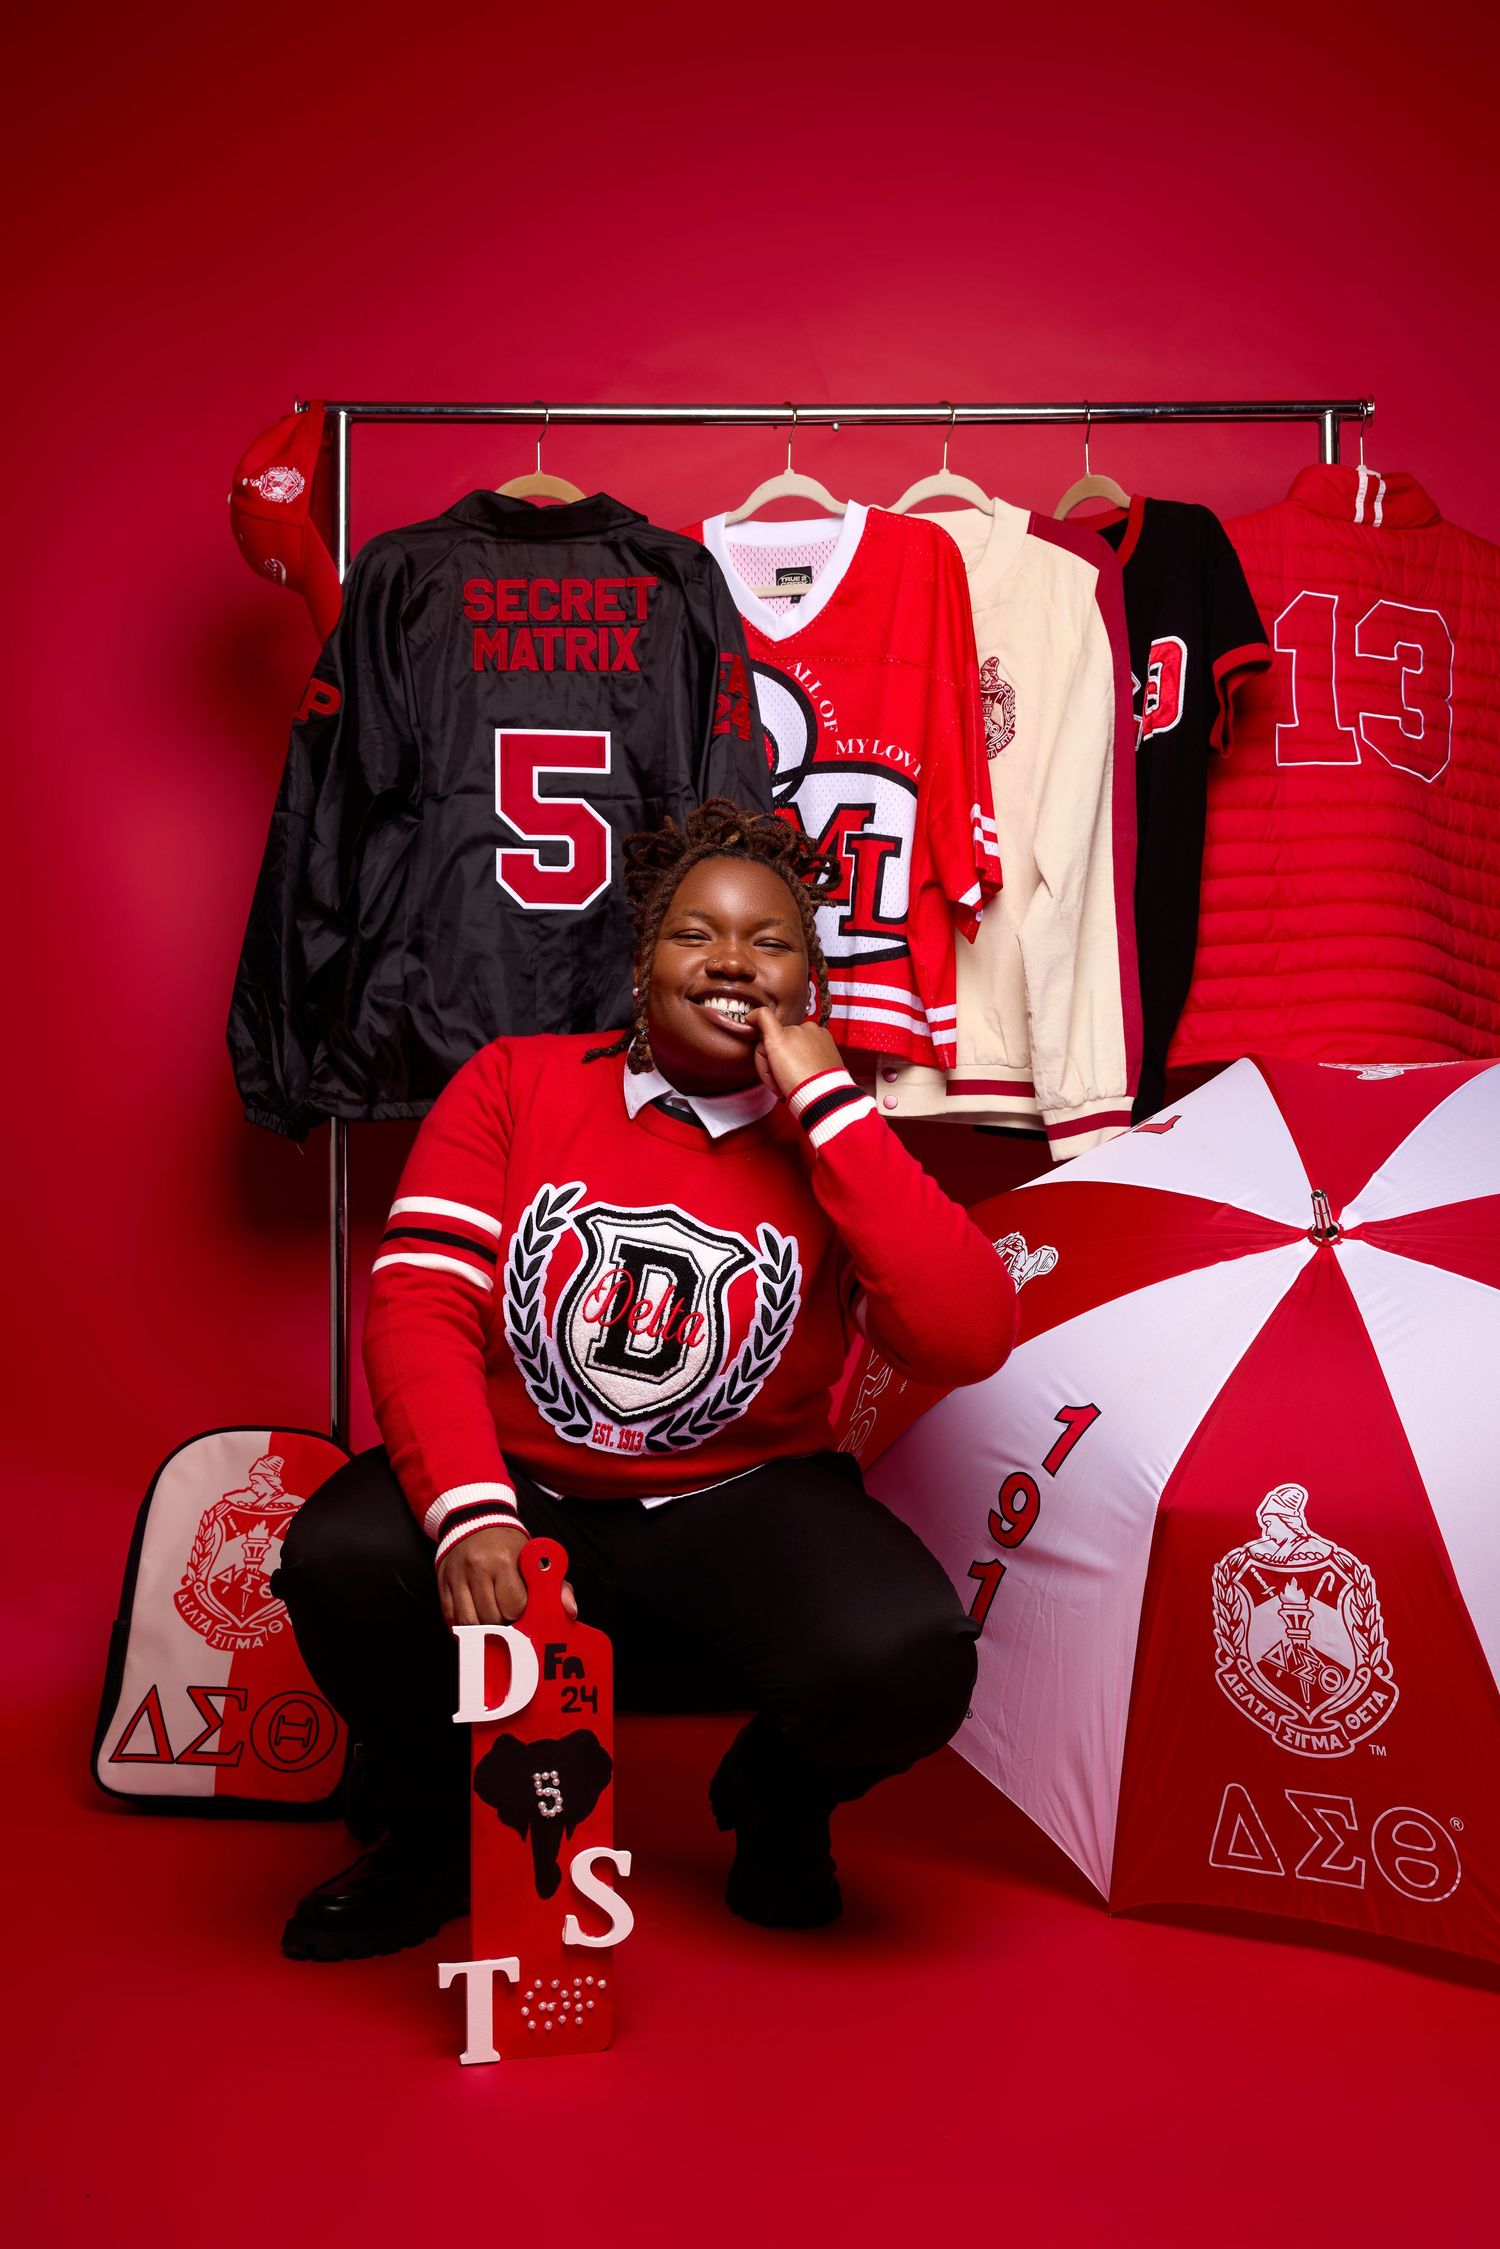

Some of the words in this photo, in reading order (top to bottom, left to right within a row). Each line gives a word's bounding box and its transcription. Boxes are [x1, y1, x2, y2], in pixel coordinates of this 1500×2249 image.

[463, 576, 658, 622] SECRET
[473, 627, 641, 672] MATRIX
[1274, 590, 1454, 783] 13
[293, 677, 342, 721] P
[787, 662, 822, 699] ALL
[819, 700, 839, 733] OF
[836, 738, 869, 755] MY
[494, 728, 611, 910] 5
[582, 1268, 706, 1348] Delta
[585, 1235, 706, 1386] D
[592, 1421, 614, 1447] EST.
[617, 1428, 644, 1451] 1913
[560, 1685, 598, 1714] 24
[532, 1770, 563, 1819] 5
[562, 1846, 634, 1949] S
[437, 1956, 520, 2065] T
